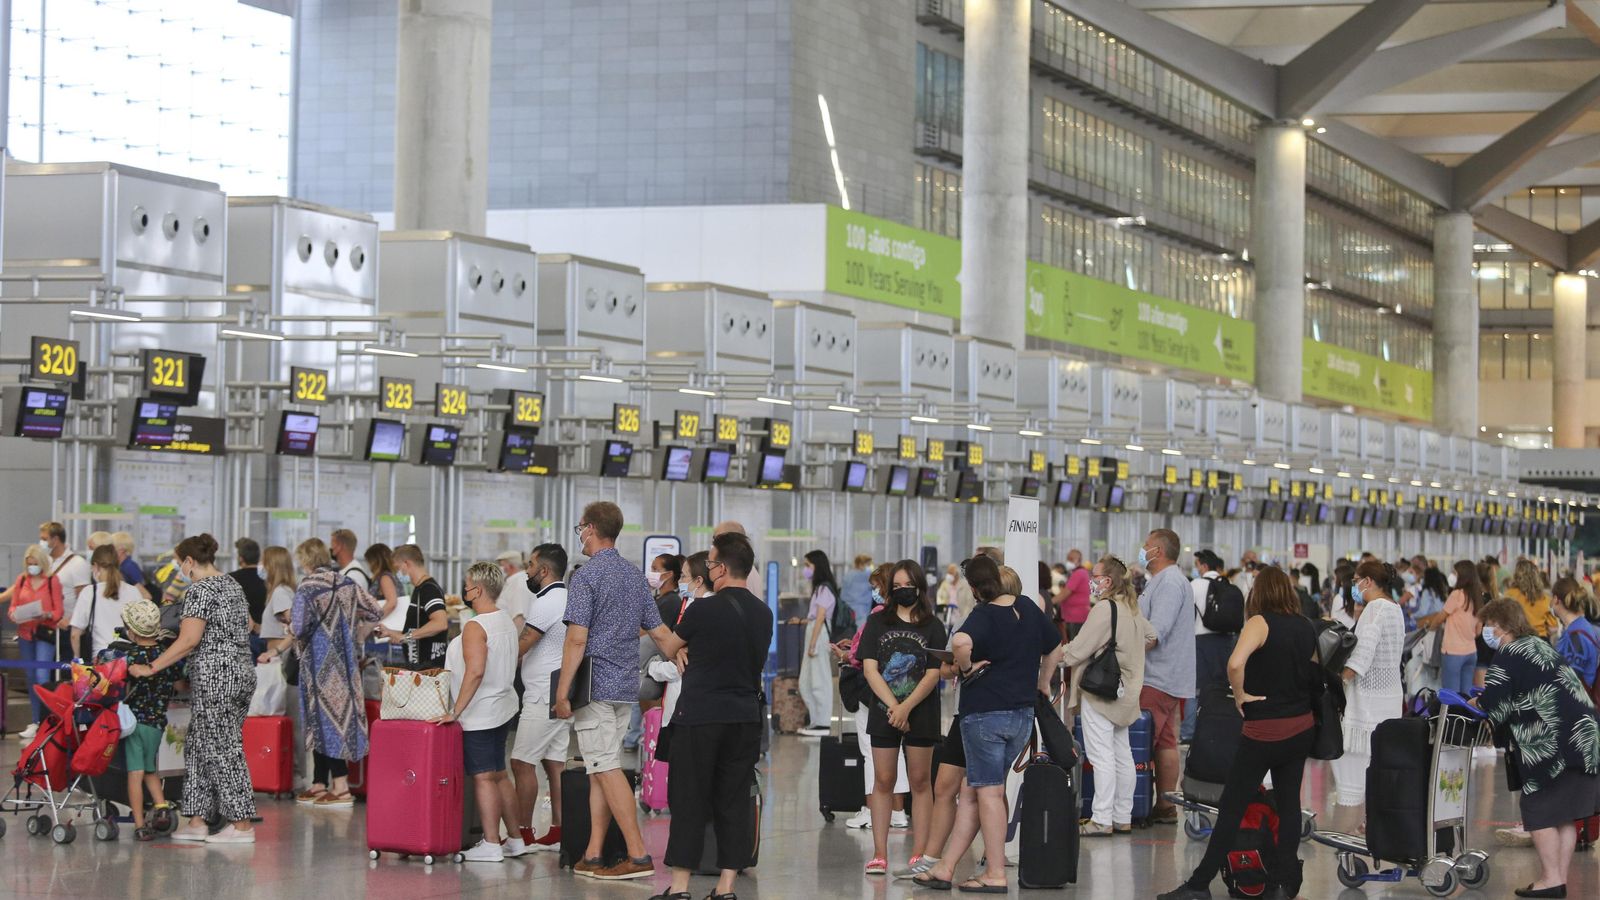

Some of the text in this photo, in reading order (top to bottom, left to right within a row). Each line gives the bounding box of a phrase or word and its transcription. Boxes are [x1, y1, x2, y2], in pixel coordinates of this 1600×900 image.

[847, 223, 926, 270] 100 años contigo
[845, 260, 865, 286] 100
[867, 265, 892, 292] Years
[894, 271, 925, 306] Serving
[39, 343, 76, 376] 320
[152, 356, 184, 387] 321
[296, 371, 327, 401] 322
[385, 383, 413, 409] 323
[441, 388, 467, 415] 324
[516, 396, 541, 422] 325
[618, 407, 640, 432] 326
[678, 415, 699, 437] 327
[718, 417, 737, 440] 328
[772, 422, 790, 445] 329
[857, 433, 873, 454] 330
[1009, 520, 1037, 533] FINNAIR
[879, 630, 928, 648] MYSTICAL
